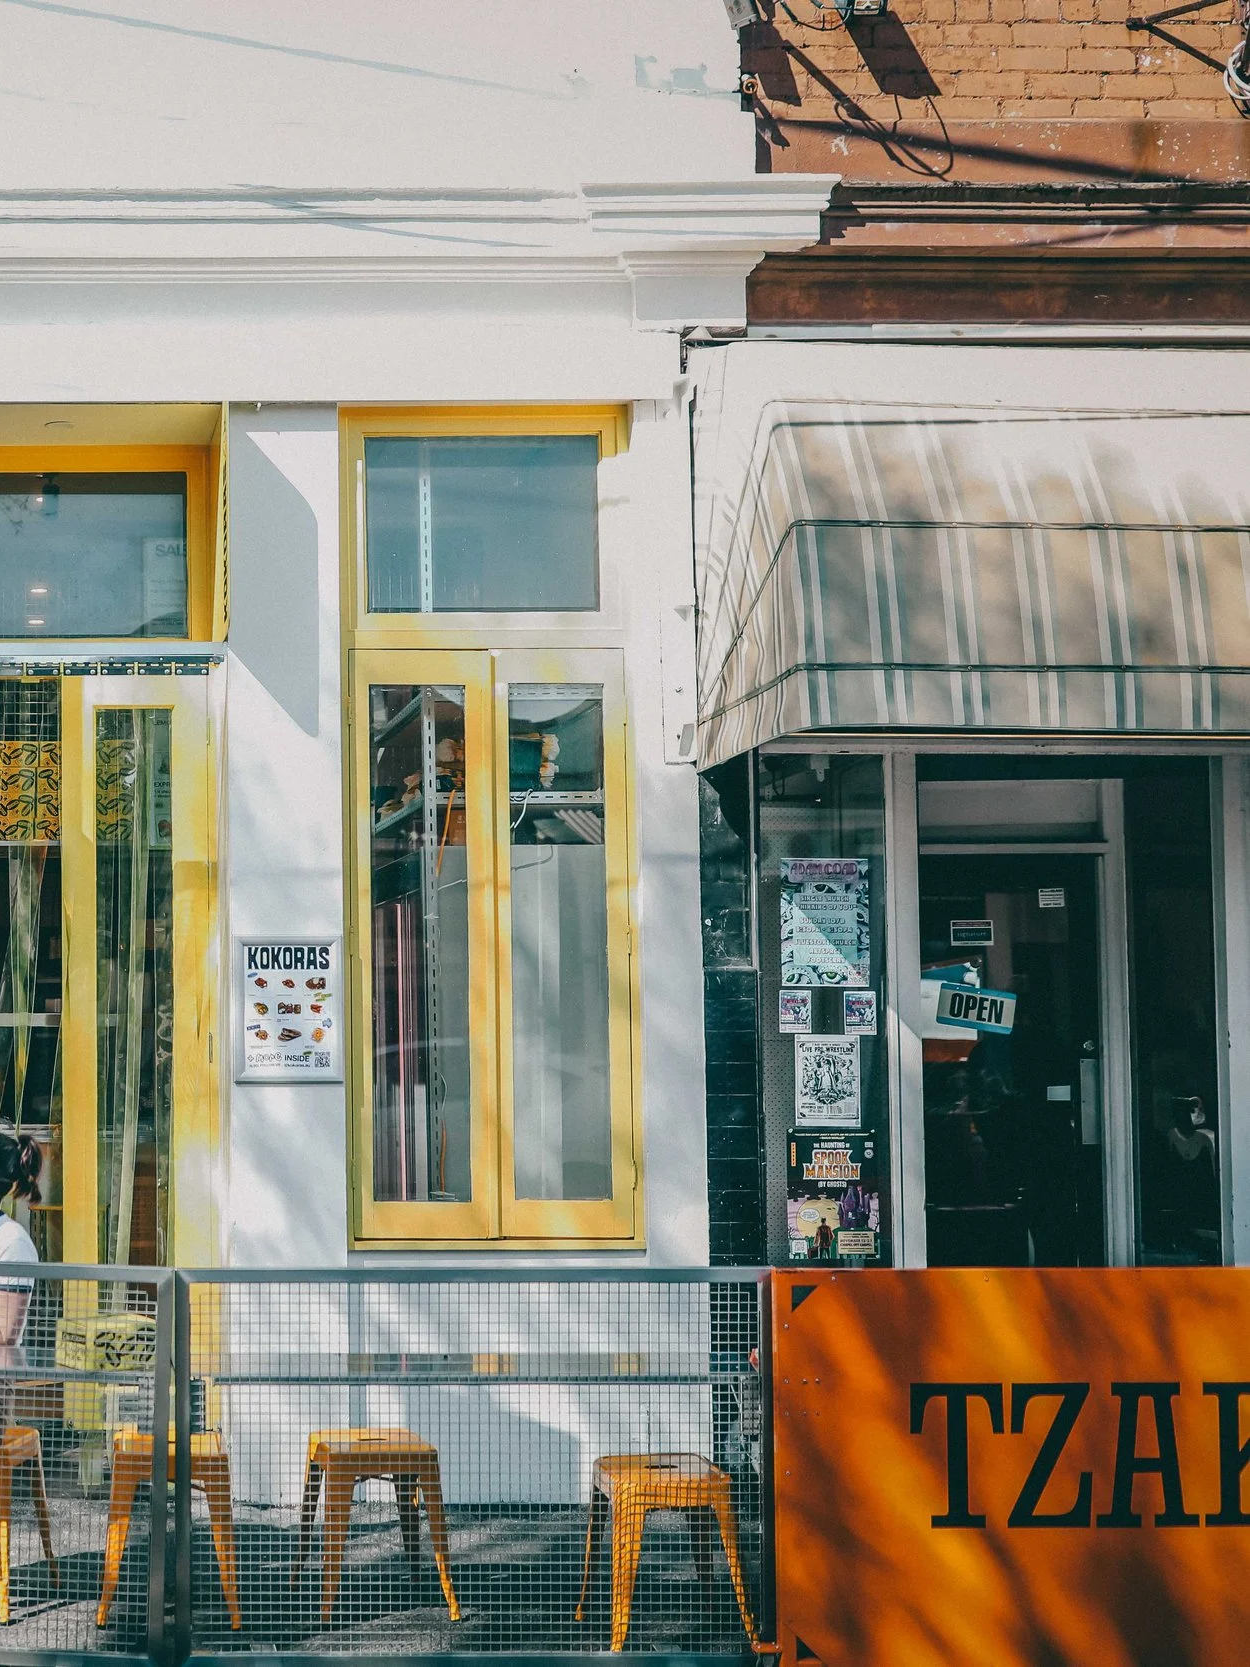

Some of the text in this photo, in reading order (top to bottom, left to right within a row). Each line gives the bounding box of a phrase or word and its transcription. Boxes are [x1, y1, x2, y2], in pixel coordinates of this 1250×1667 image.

[790, 863, 858, 876] ADAM COAD
[247, 946, 330, 970] KOKORAS
[949, 992, 1005, 1025] OPEN
[284, 1054, 310, 1062] INSIDE
[813, 1150, 852, 1165] SPOOK
[804, 1164, 860, 1179] MANSION
